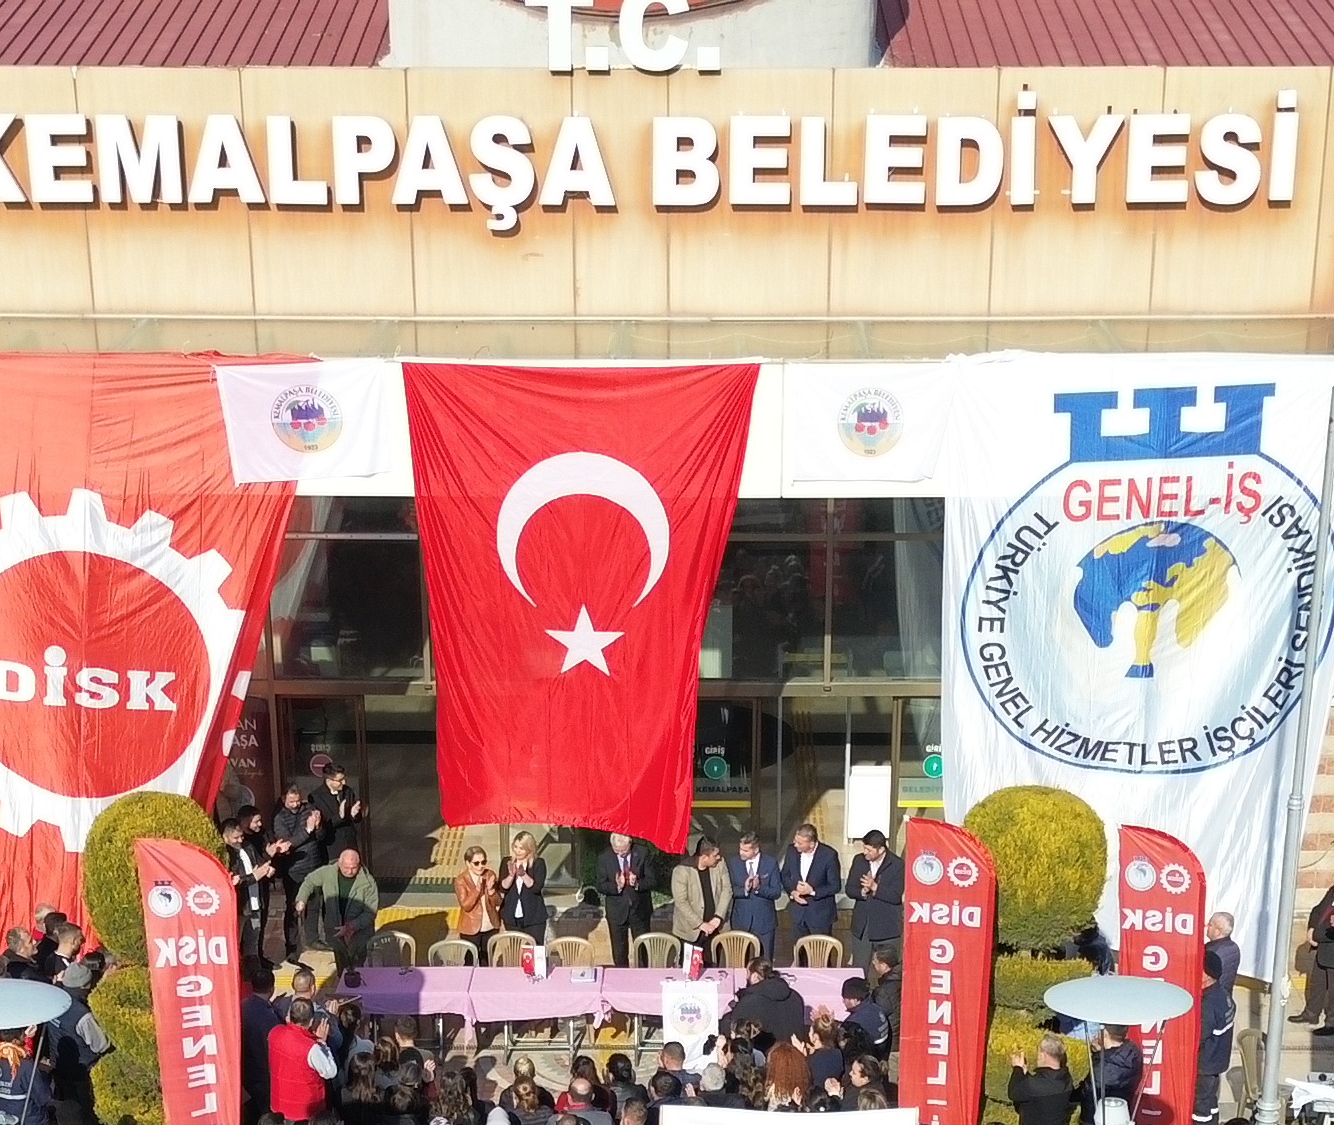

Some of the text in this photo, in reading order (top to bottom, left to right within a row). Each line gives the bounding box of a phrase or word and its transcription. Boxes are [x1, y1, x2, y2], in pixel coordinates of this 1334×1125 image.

[530, 0, 720, 72] T.C.
[652, 89, 1299, 207] BELEDİYESİ
[1063, 462, 1262, 525] GENEL-İŞ
[977, 511, 1059, 634] TÜRKİYE
[979, 641, 1033, 730] GENEL
[1203, 656, 1305, 762] İŞÇİLERİ
[1030, 717, 1202, 765] HİZMETLER
